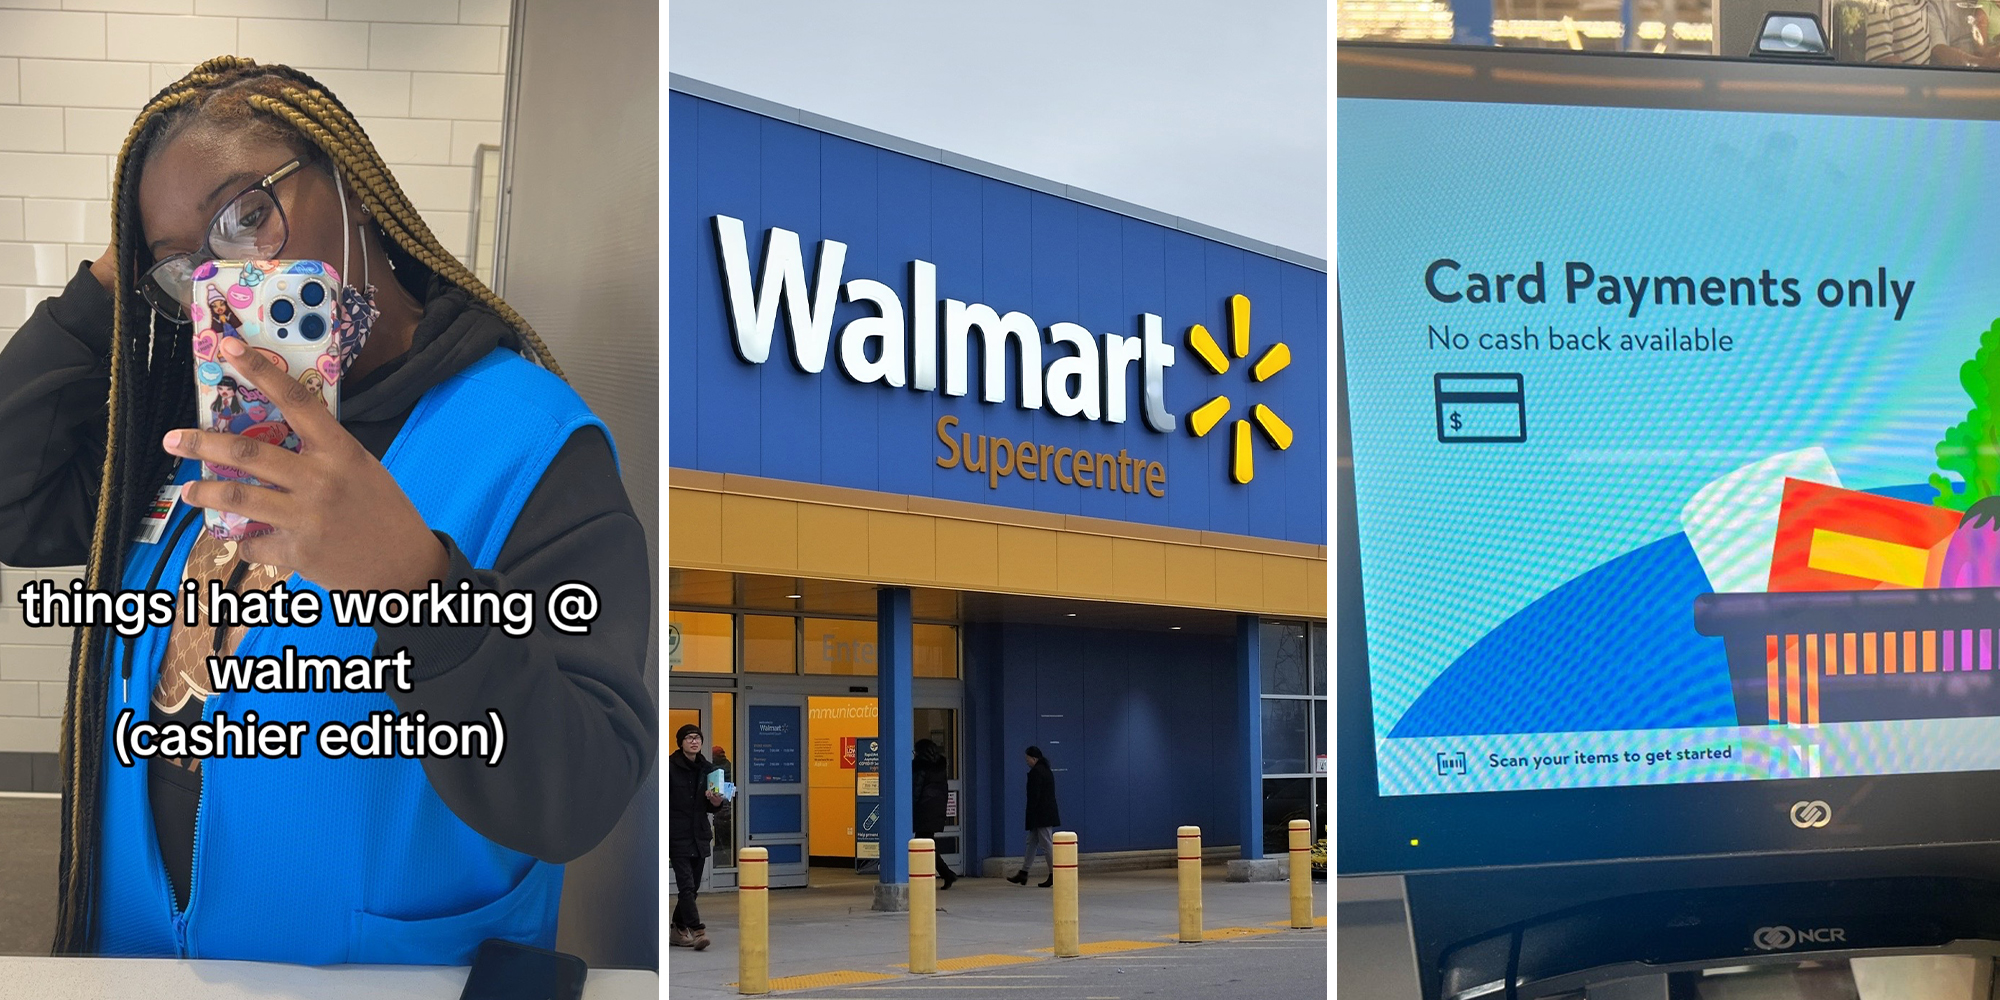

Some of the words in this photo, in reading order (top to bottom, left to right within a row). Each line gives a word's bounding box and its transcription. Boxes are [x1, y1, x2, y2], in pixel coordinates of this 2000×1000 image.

[1424, 257, 1547, 305] Card
[1565, 261, 1802, 319] Payments
[1816, 267, 1916, 321] only
[713, 213, 1176, 433] Walmart
[1428, 325, 1470, 351] No
[1478, 326, 1539, 351] cash
[1548, 327, 1612, 352] back
[1619, 327, 1735, 353] available
[936, 415, 1167, 498] Supercentre
[822, 633, 878, 664] Ente
[760, 724, 782, 732] Walmart
[1488, 752, 1530, 769] Scan
[1533, 753, 1570, 770] your
[1574, 749, 1619, 767] items
[1623, 748, 1641, 764] to
[1645, 748, 1673, 769] get
[1676, 744, 1734, 764] started
[1799, 926, 1848, 945] NCR
